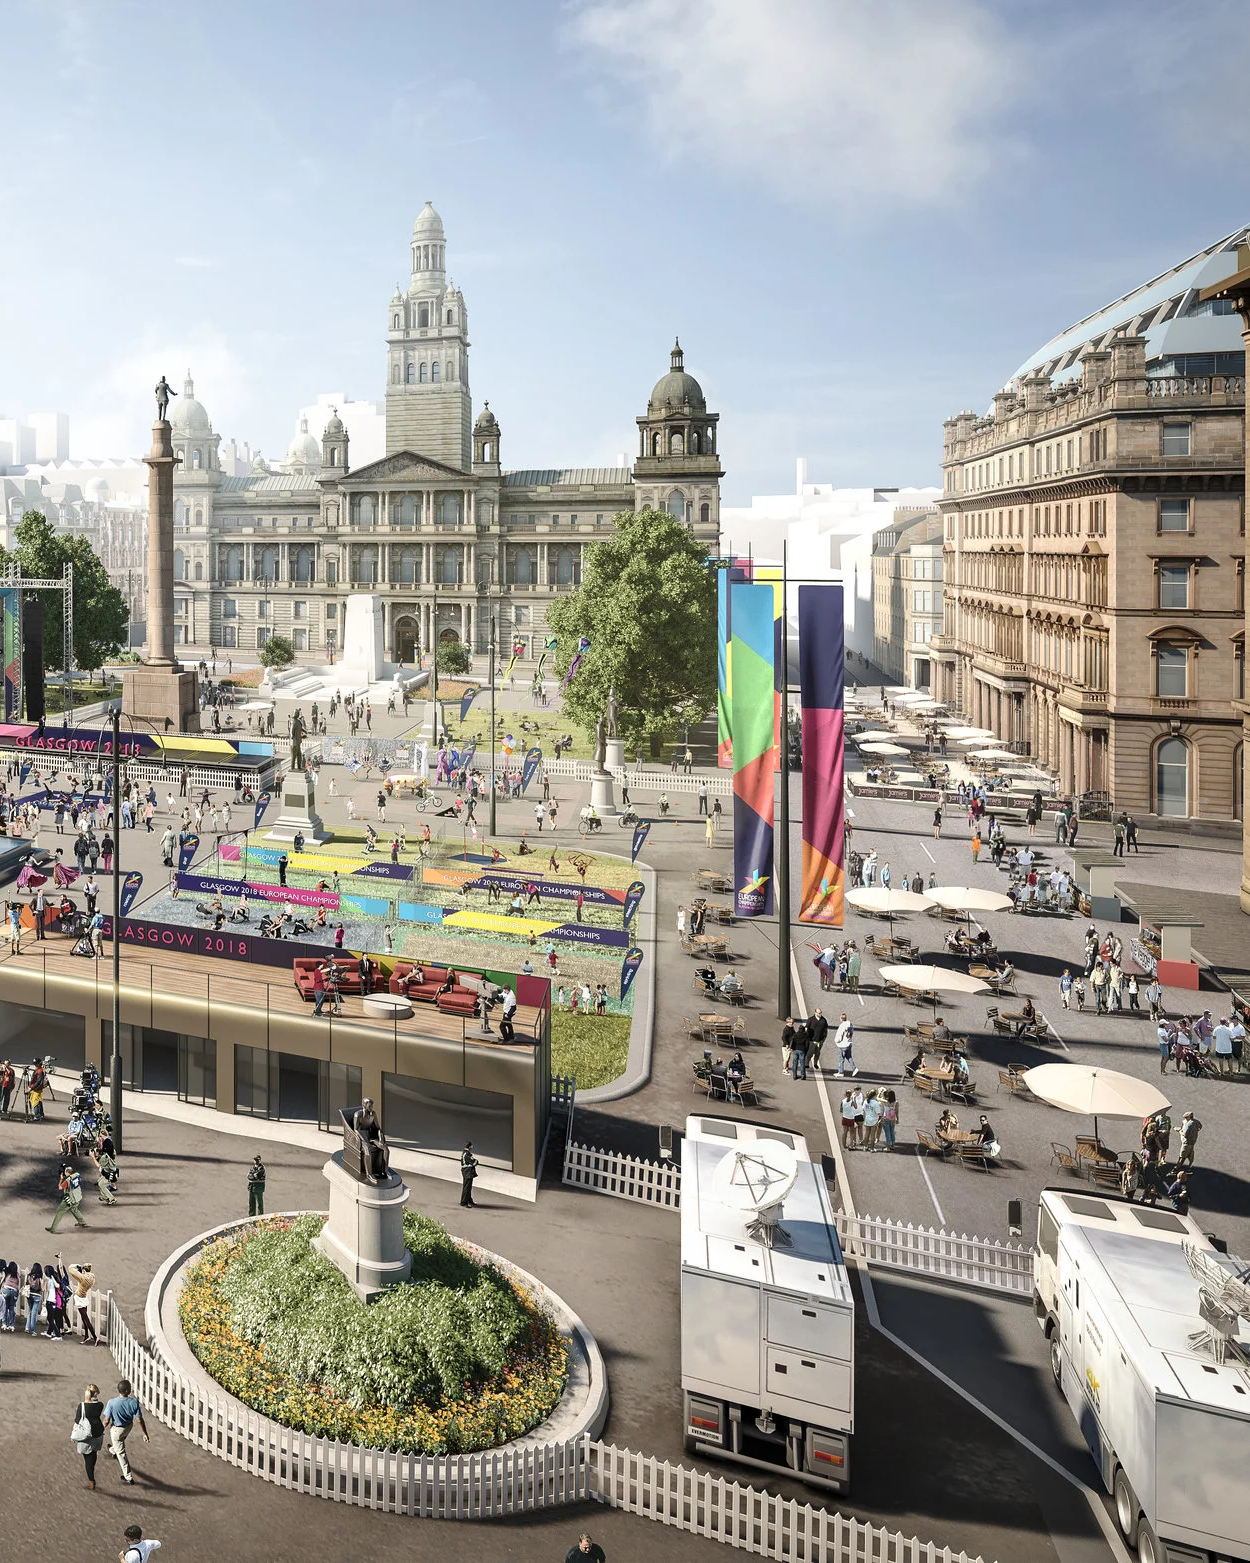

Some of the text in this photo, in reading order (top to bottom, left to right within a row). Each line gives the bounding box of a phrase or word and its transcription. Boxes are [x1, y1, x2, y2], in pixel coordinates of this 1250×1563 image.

[15, 735, 97, 752] GLASGOW
[239, 851, 276, 861] GLASGOW
[500, 880, 541, 892] EURON
[200, 881, 362, 909] GLASGOW 2018 EUROPEAN CHAMPIONSHIPS
[102, 922, 247, 956] GASGOW 2018
[691, 1428, 720, 1440] EVERMOTION
